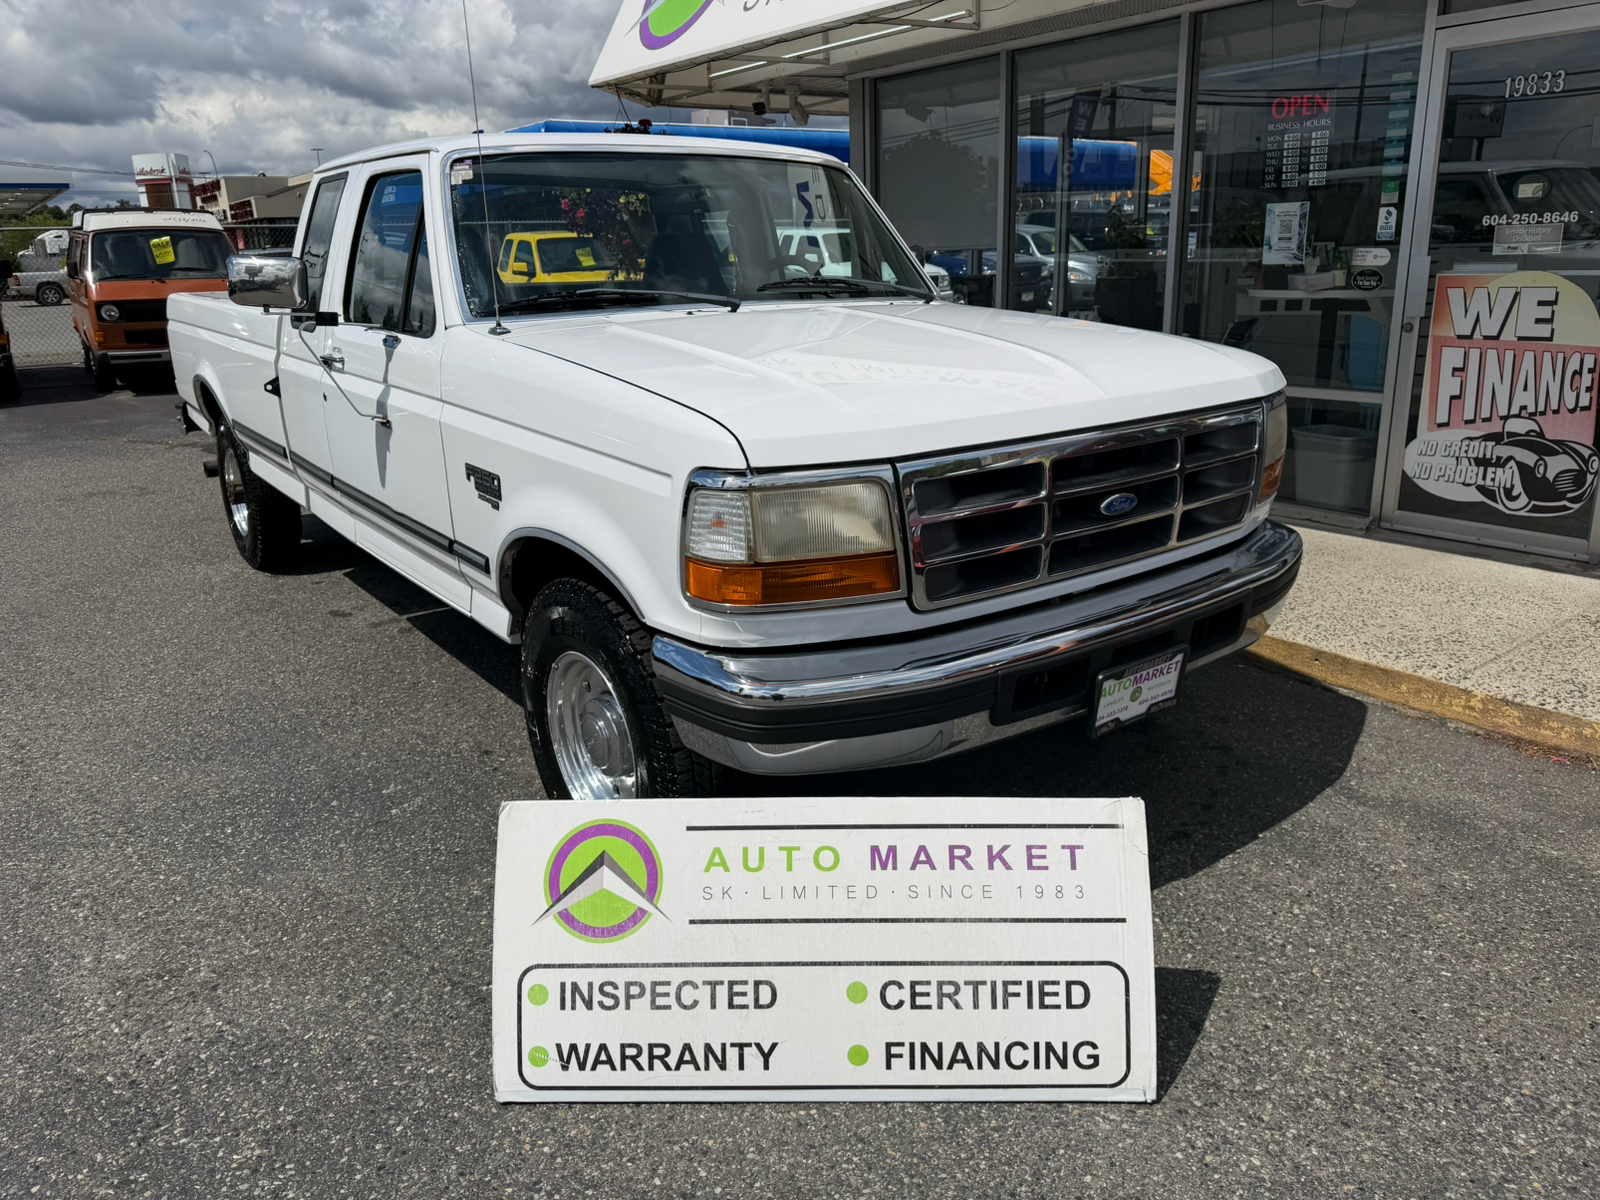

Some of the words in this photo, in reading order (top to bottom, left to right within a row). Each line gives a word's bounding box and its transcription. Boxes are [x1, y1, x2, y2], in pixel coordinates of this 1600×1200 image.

[1504, 69, 1566, 98] 19833
[1271, 92, 1331, 120] OPEN
[1267, 121, 1301, 131] BUSINESS
[1303, 118, 1332, 128] HOURS
[1481, 211, 1579, 226] 604-250-8646
[1505, 227, 1528, 235] Vehicle
[1528, 226, 1552, 235] History
[1512, 234, 1542, 242] Disclosed
[1446, 287, 1559, 340] WE
[1435, 346, 1597, 427] FINANCE
[1417, 440, 1438, 456] NO
[1411, 461, 1432, 479] NO
[1101, 661, 1181, 698] AUTOMARKET
[1103, 697, 1125, 709] LANGLEY
[703, 845, 841, 873] AUTO
[870, 844, 1085, 871] MARKET
[1016, 884, 1085, 899] 1983
[558, 979, 778, 1011] INSPECTED
[879, 978, 1091, 1011] CERTIFIED
[555, 1041, 779, 1072] WARRANTY
[885, 1039, 1101, 1071] FINANCING
